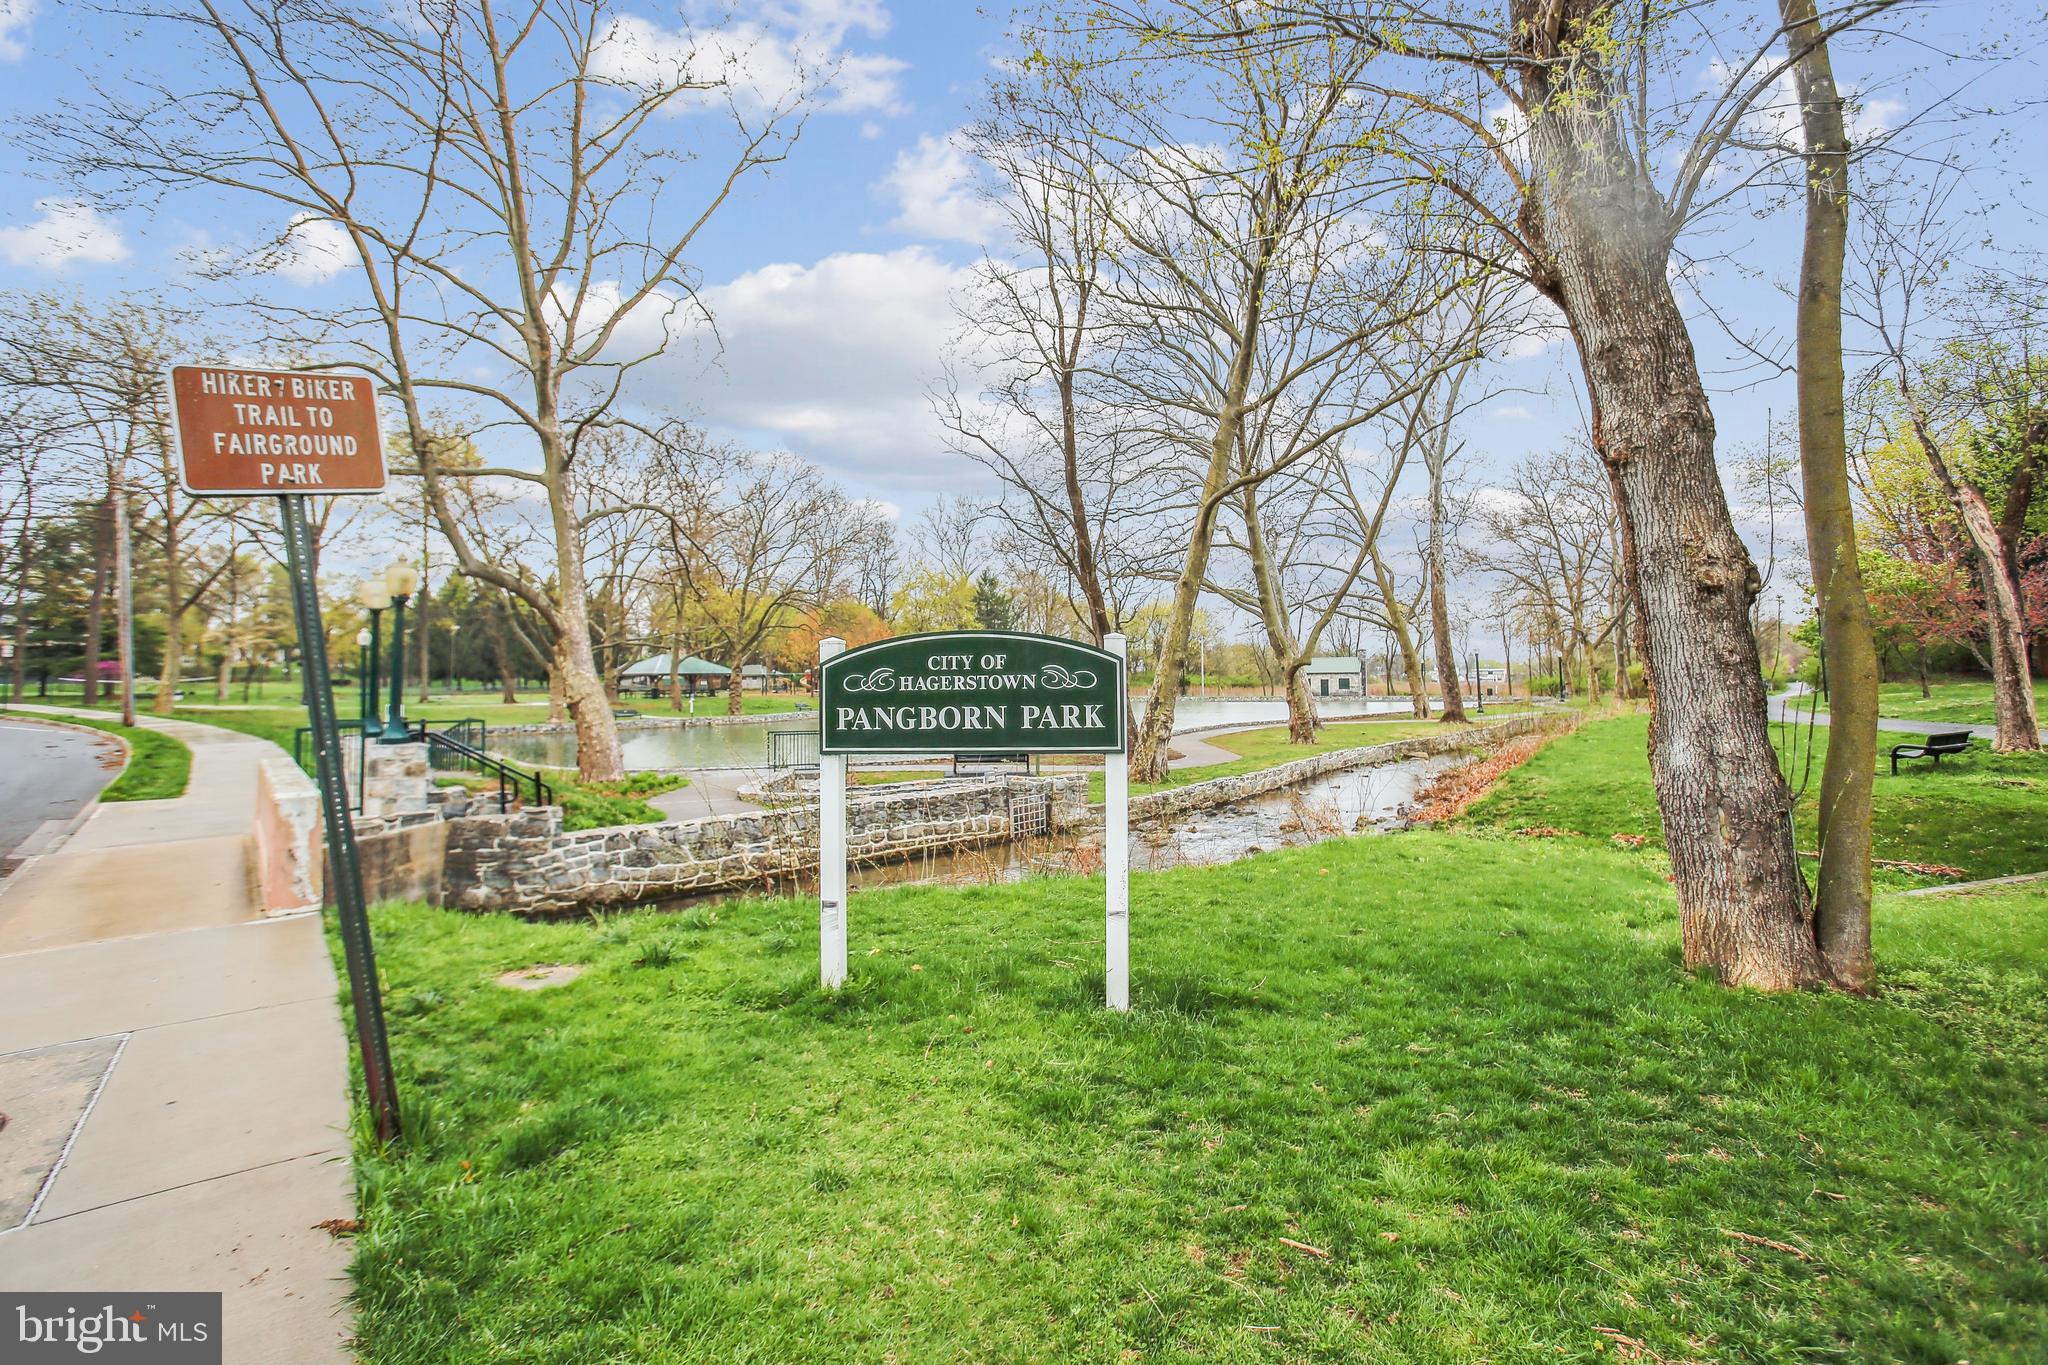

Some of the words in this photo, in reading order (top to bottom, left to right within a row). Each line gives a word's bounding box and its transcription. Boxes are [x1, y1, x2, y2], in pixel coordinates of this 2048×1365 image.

[202, 373, 272, 397] HIKER
[291, 378, 355, 400] BIKER
[233, 404, 302, 427] TRAIL
[306, 407, 334, 428] TO
[213, 432, 358, 456] FAIRGROUND
[260, 463, 323, 485] PARK
[927, 655, 973, 671] CITY
[980, 654, 1007, 670] OF
[899, 674, 1037, 691] HAGERSTOWN
[836, 705, 1007, 730] PANGBORN
[1020, 704, 1105, 729] PARK
